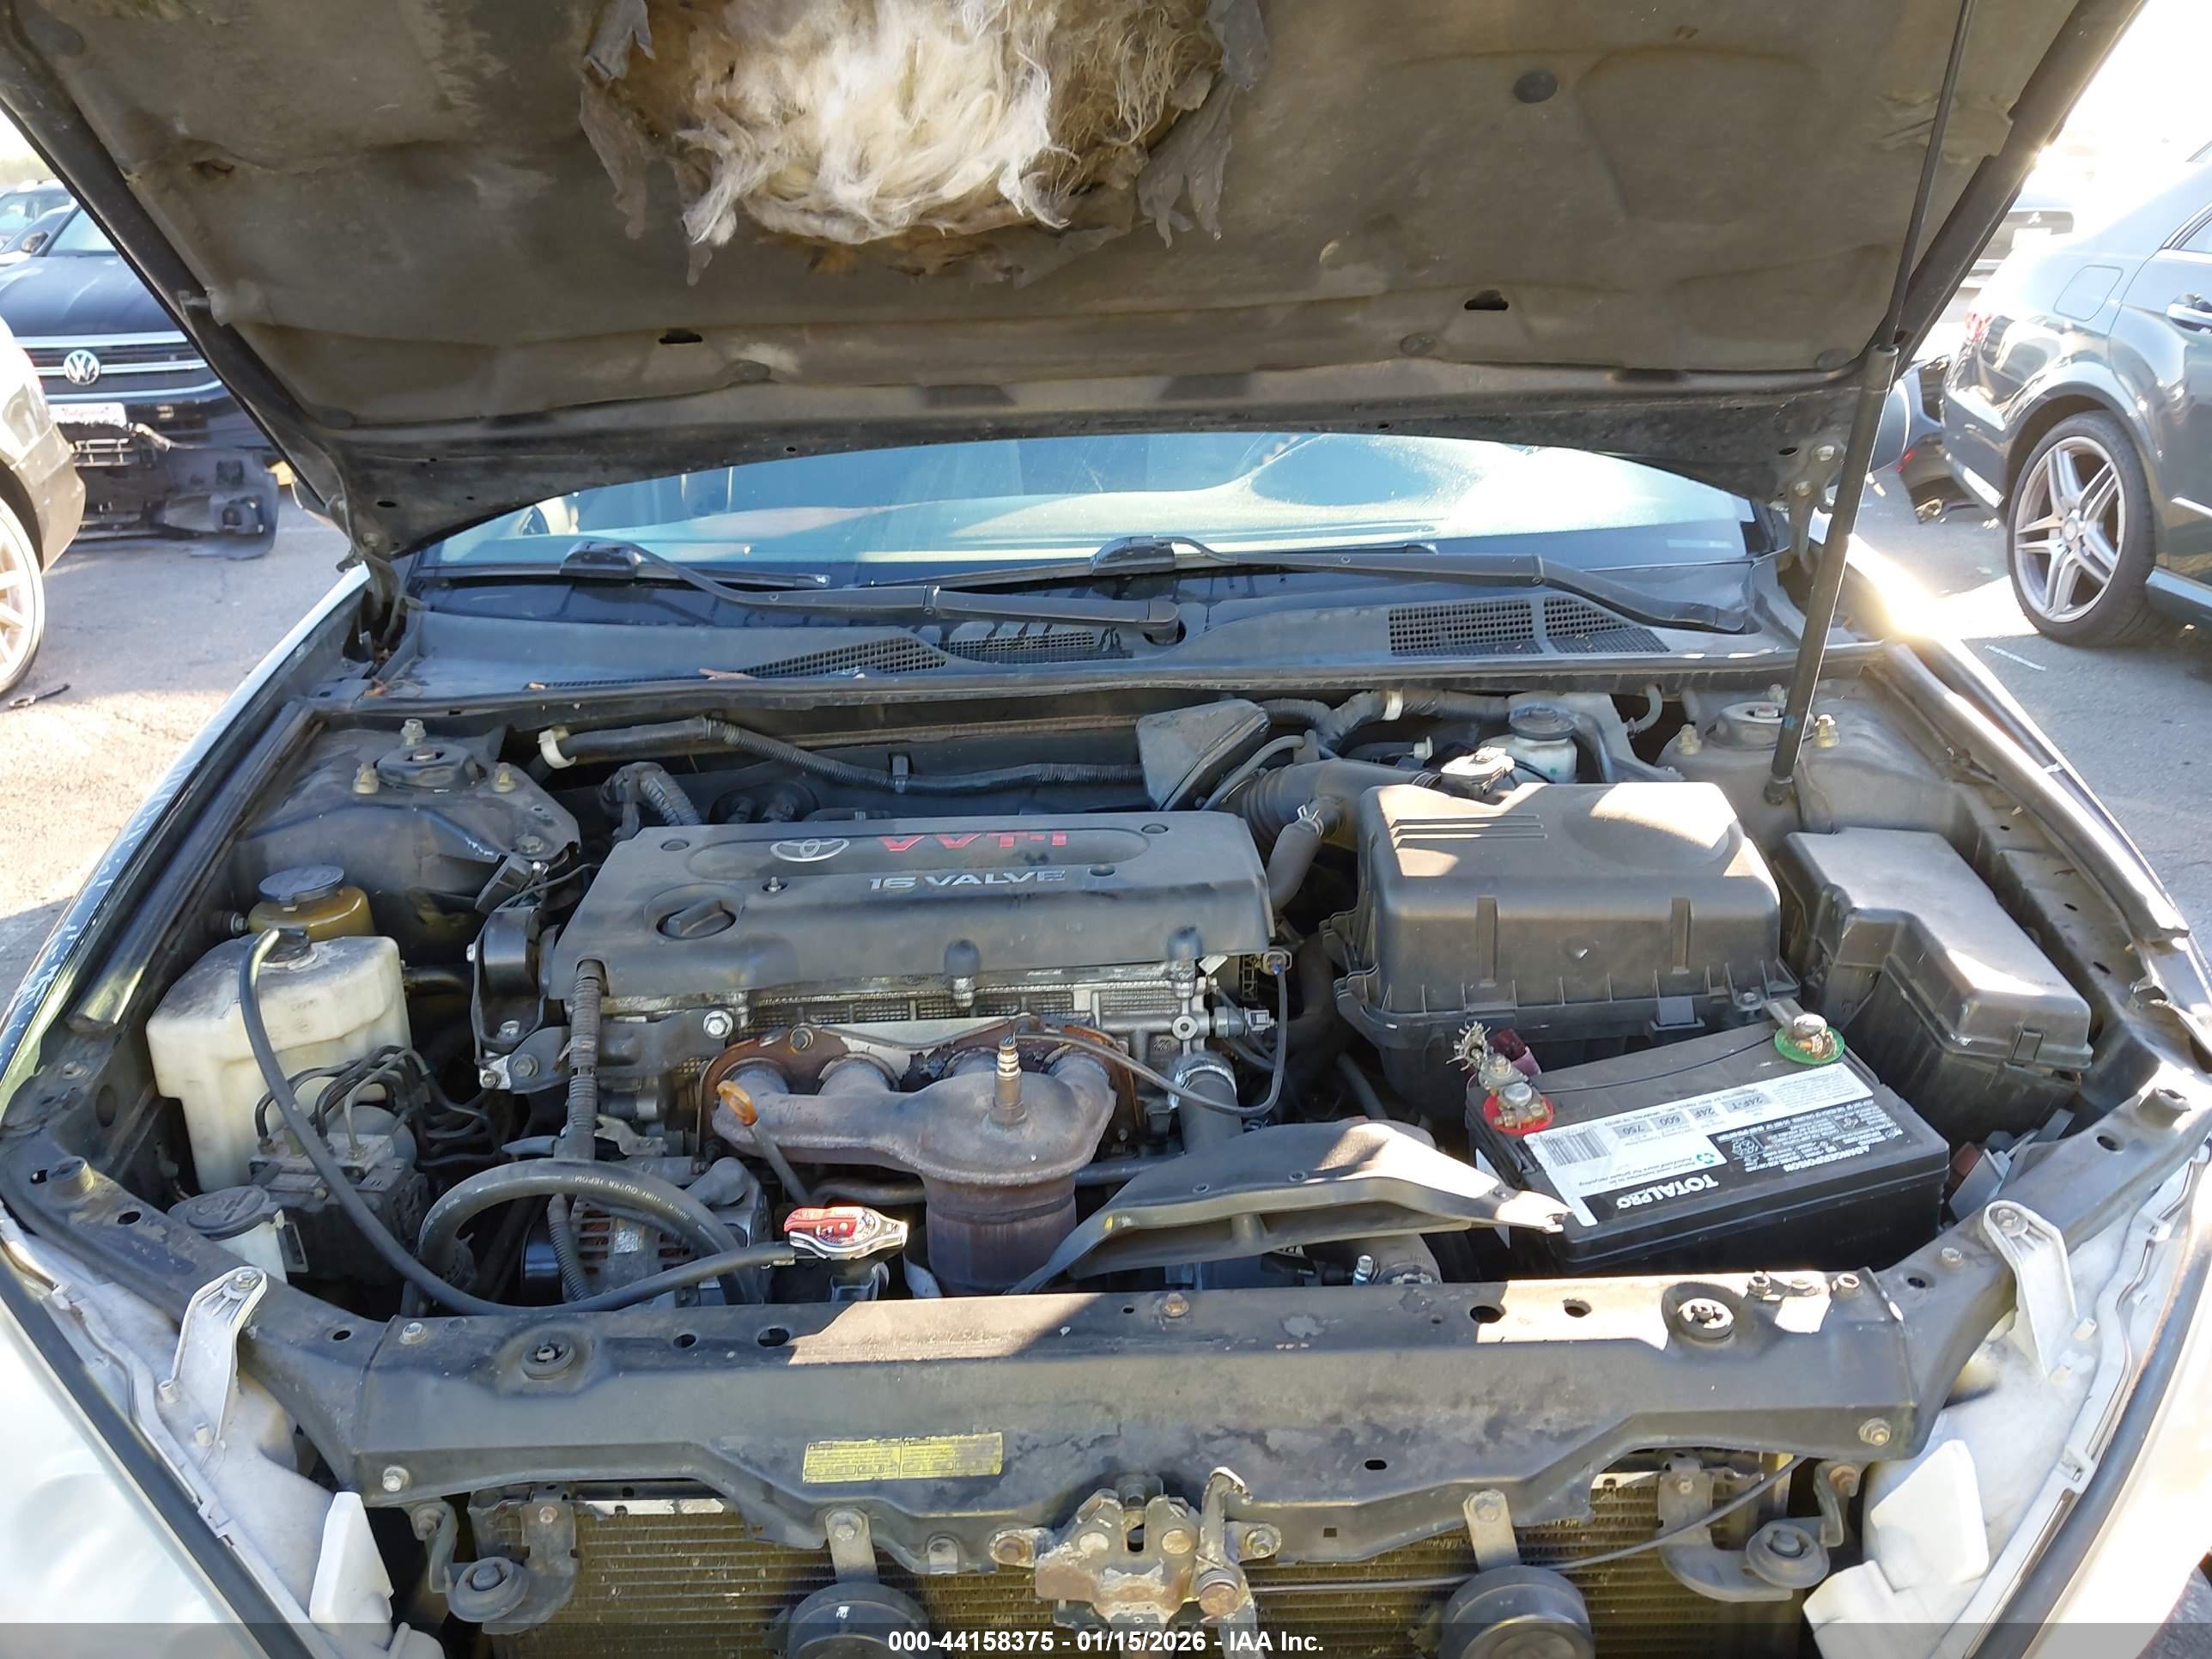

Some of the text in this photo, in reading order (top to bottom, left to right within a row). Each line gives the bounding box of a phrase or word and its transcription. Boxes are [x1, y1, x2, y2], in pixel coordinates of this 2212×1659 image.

[870, 869, 1066, 892] 16 VALVE
[1622, 1124, 1645, 1135] 750
[1616, 1174, 1719, 1209] TOTALPRO
